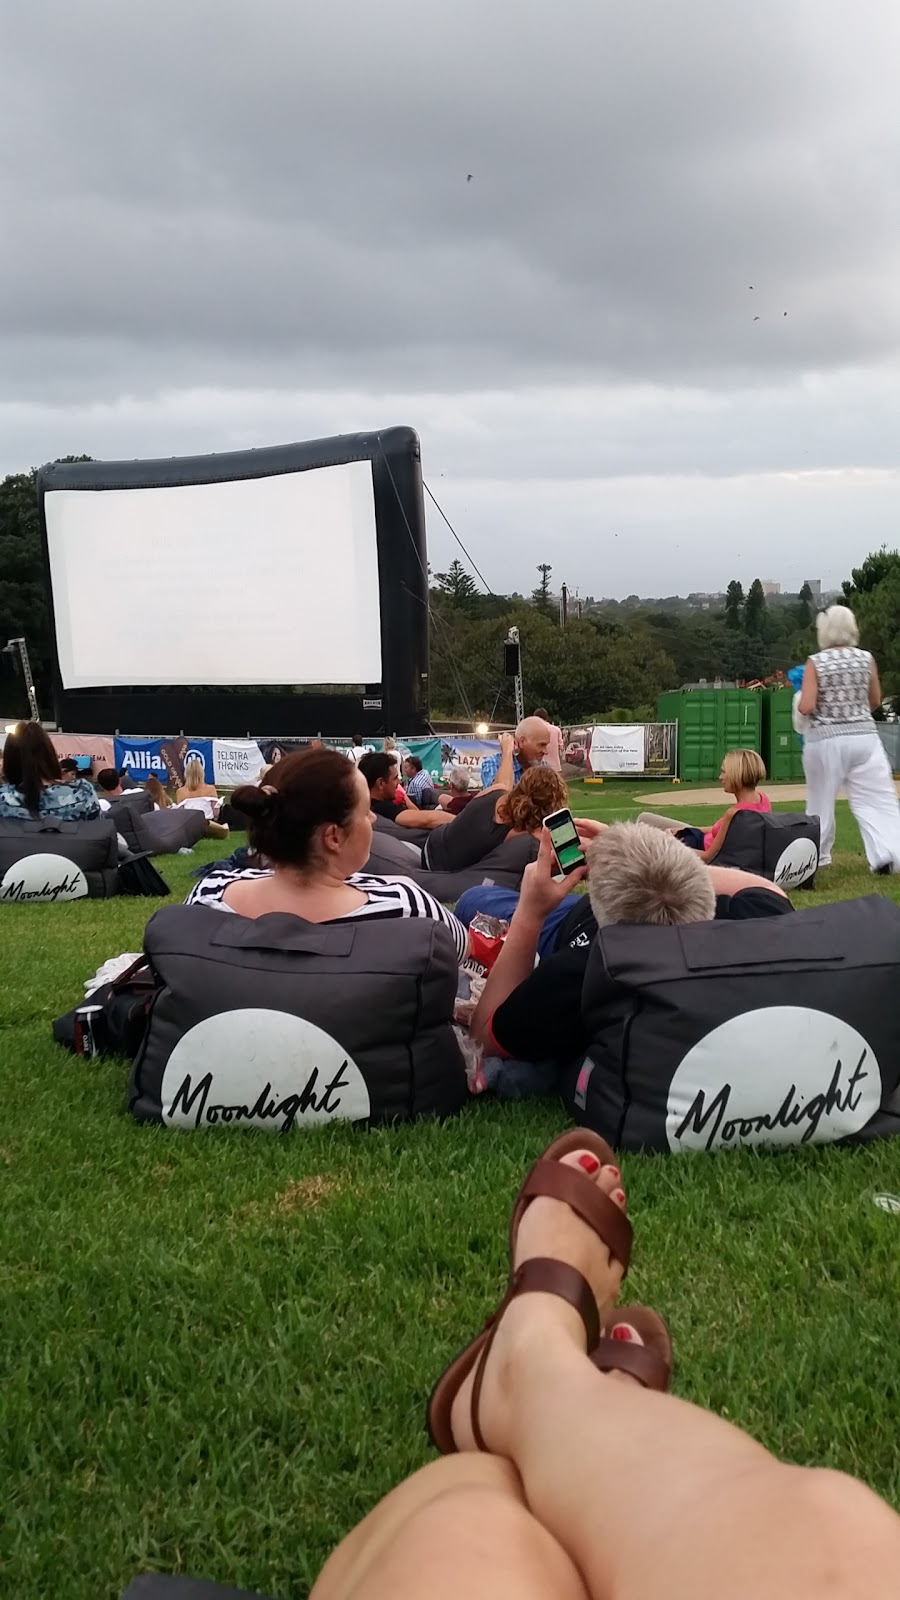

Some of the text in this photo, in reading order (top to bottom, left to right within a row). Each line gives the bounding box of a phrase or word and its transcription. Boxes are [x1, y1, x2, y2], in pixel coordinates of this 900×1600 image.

[217, 750, 249, 760] TELSTRA
[458, 756, 480, 765] LAZY
[776, 851, 817, 885] Moonlight
[2, 872, 81, 902] Moonlight
[167, 1060, 349, 1132] Moonlight
[674, 1048, 868, 1150] Moonlight
